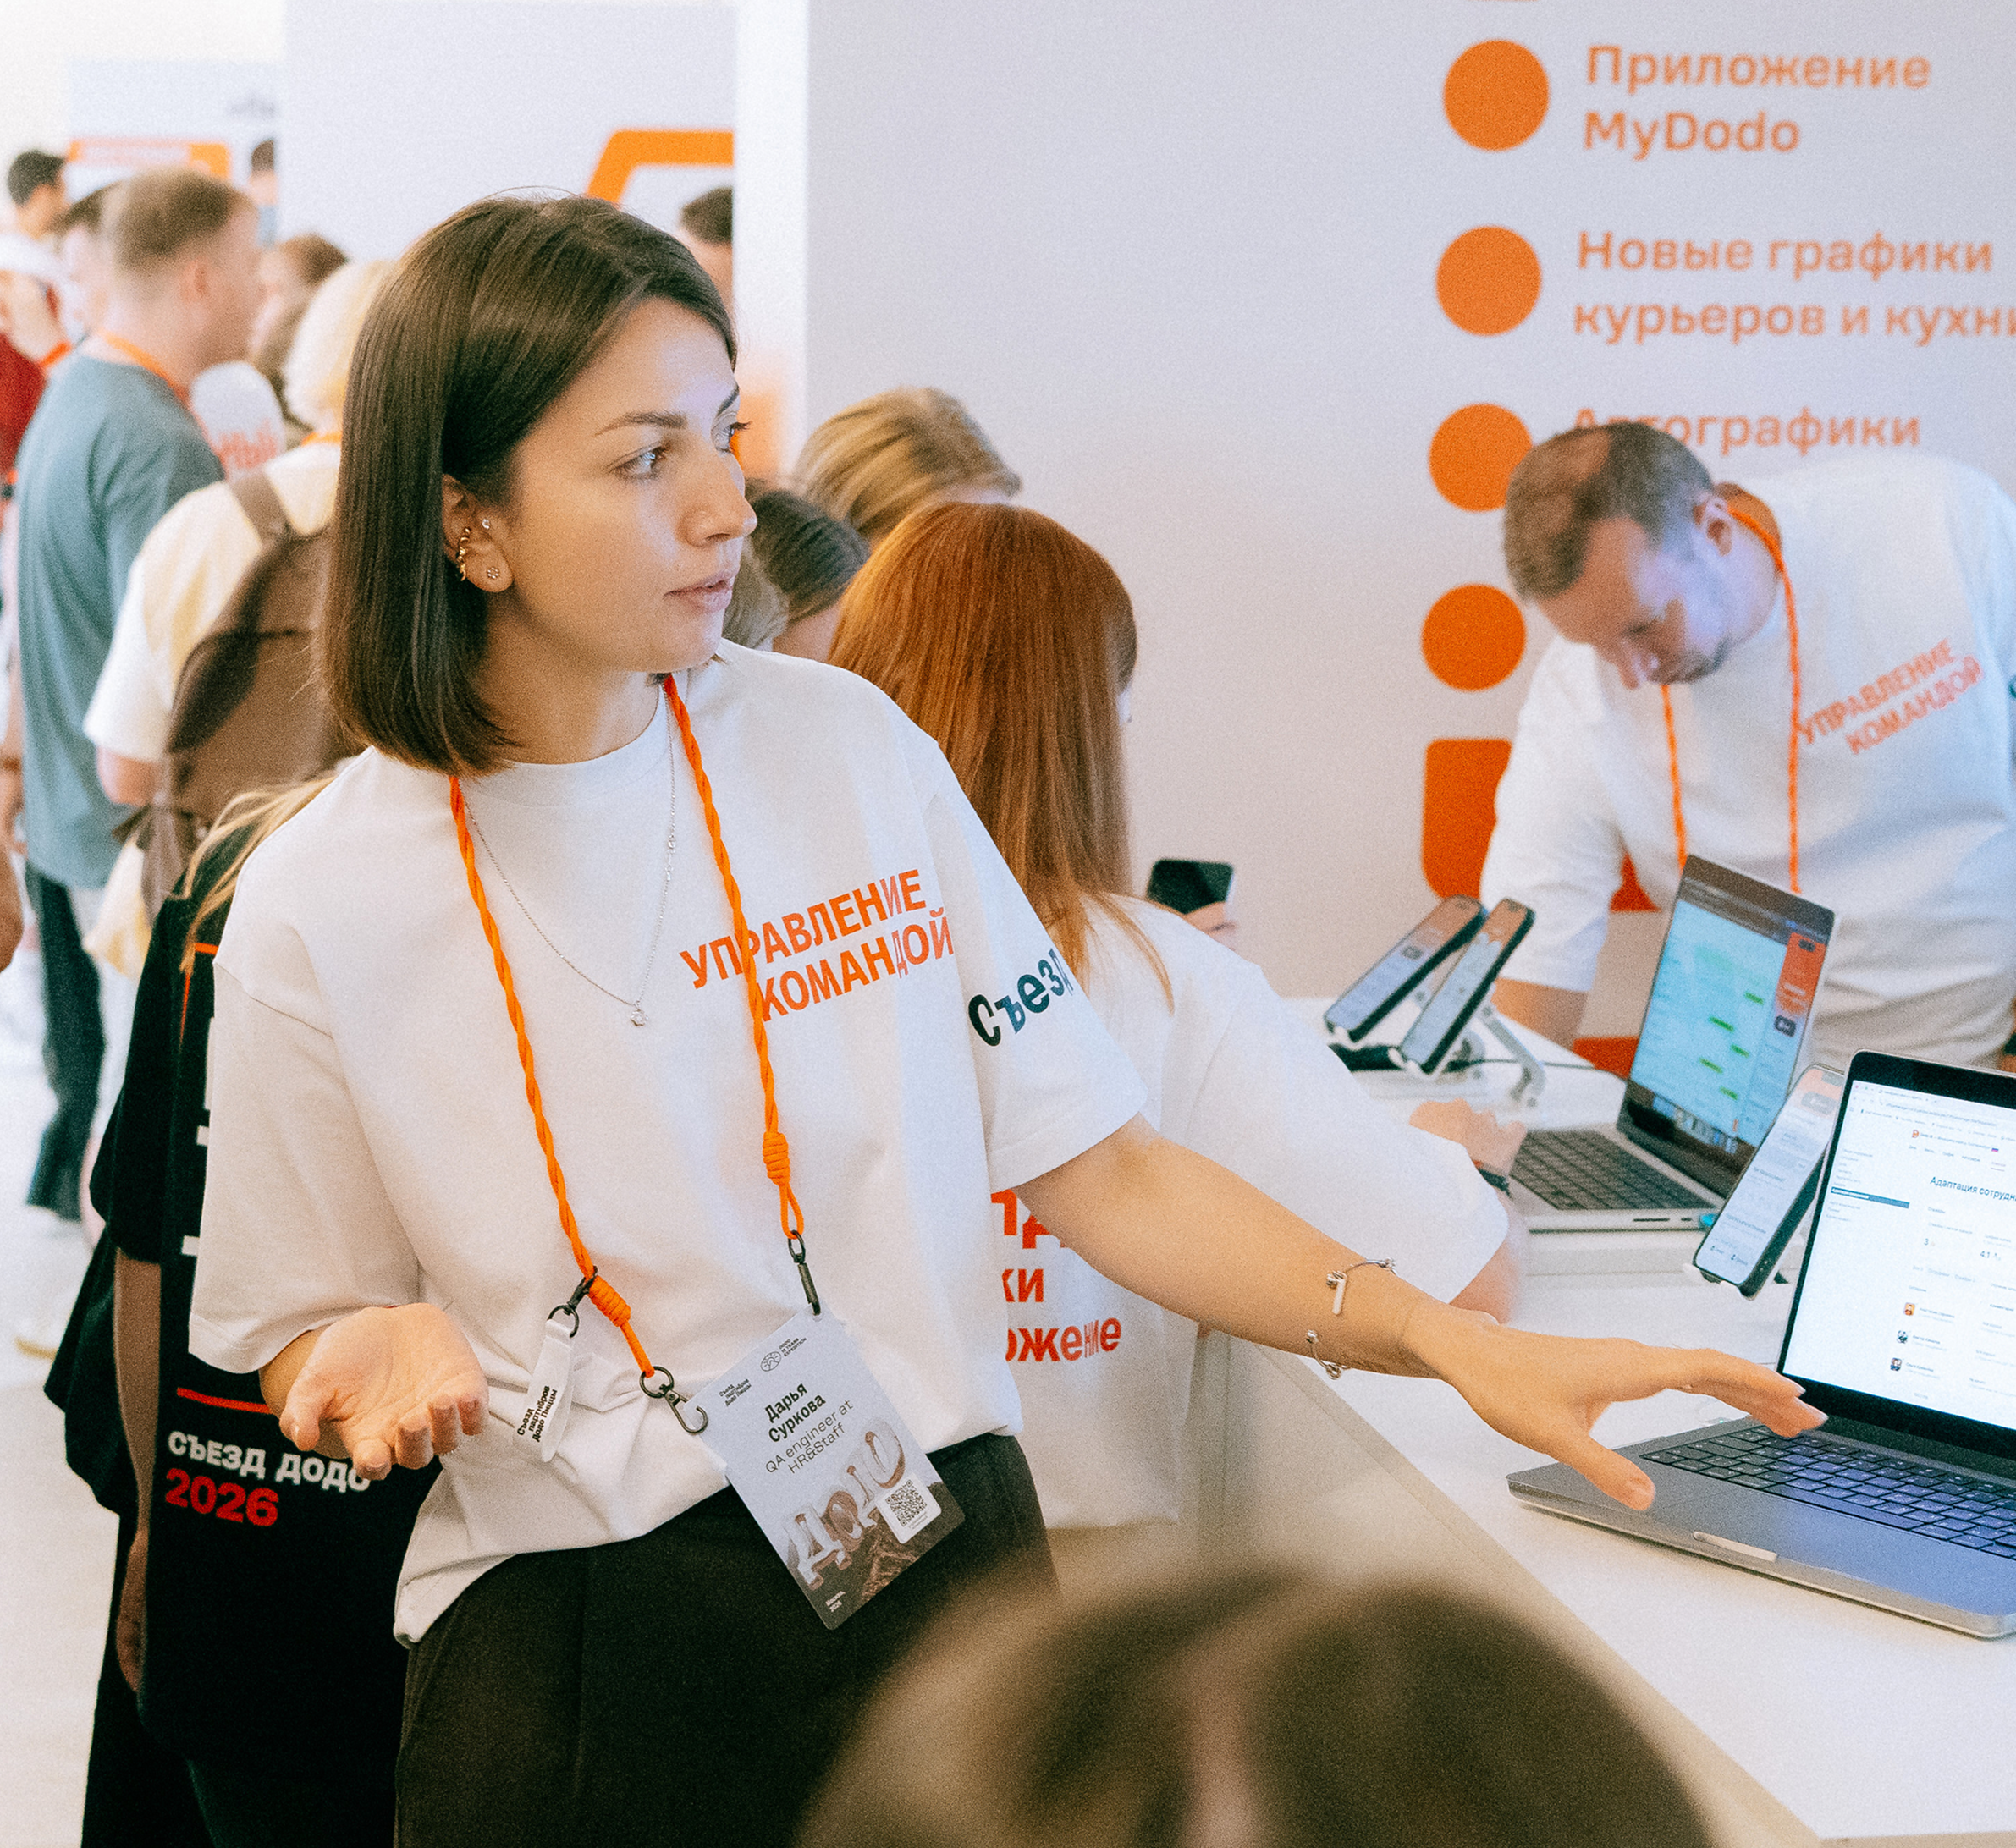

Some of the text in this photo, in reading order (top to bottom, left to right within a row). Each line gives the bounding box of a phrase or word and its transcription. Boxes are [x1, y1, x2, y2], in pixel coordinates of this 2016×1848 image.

[1587, 45, 1931, 94] Приложение
[1584, 111, 1800, 161] MyDodo
[1578, 231, 1993, 281] Новые графики
[1573, 304, 1825, 344] курьеров
[1842, 306, 1868, 336] и
[756, 907, 954, 1022] КОМАНДОЙ
[1930, 1176, 1978, 1193] Адаптация
[516, 1408, 535, 1436] Съезд
[764, 1383, 807, 1423] Дарья
[768, 1395, 826, 1442] Суркова
[168, 1430, 267, 1480] СЪЕЗД
[532, 1419, 545, 1443] Додо
[765, 1400, 853, 1473] QA engineer at
[788, 1422, 845, 1474] HR&Staff
[165, 1468, 279, 1526] 2026
